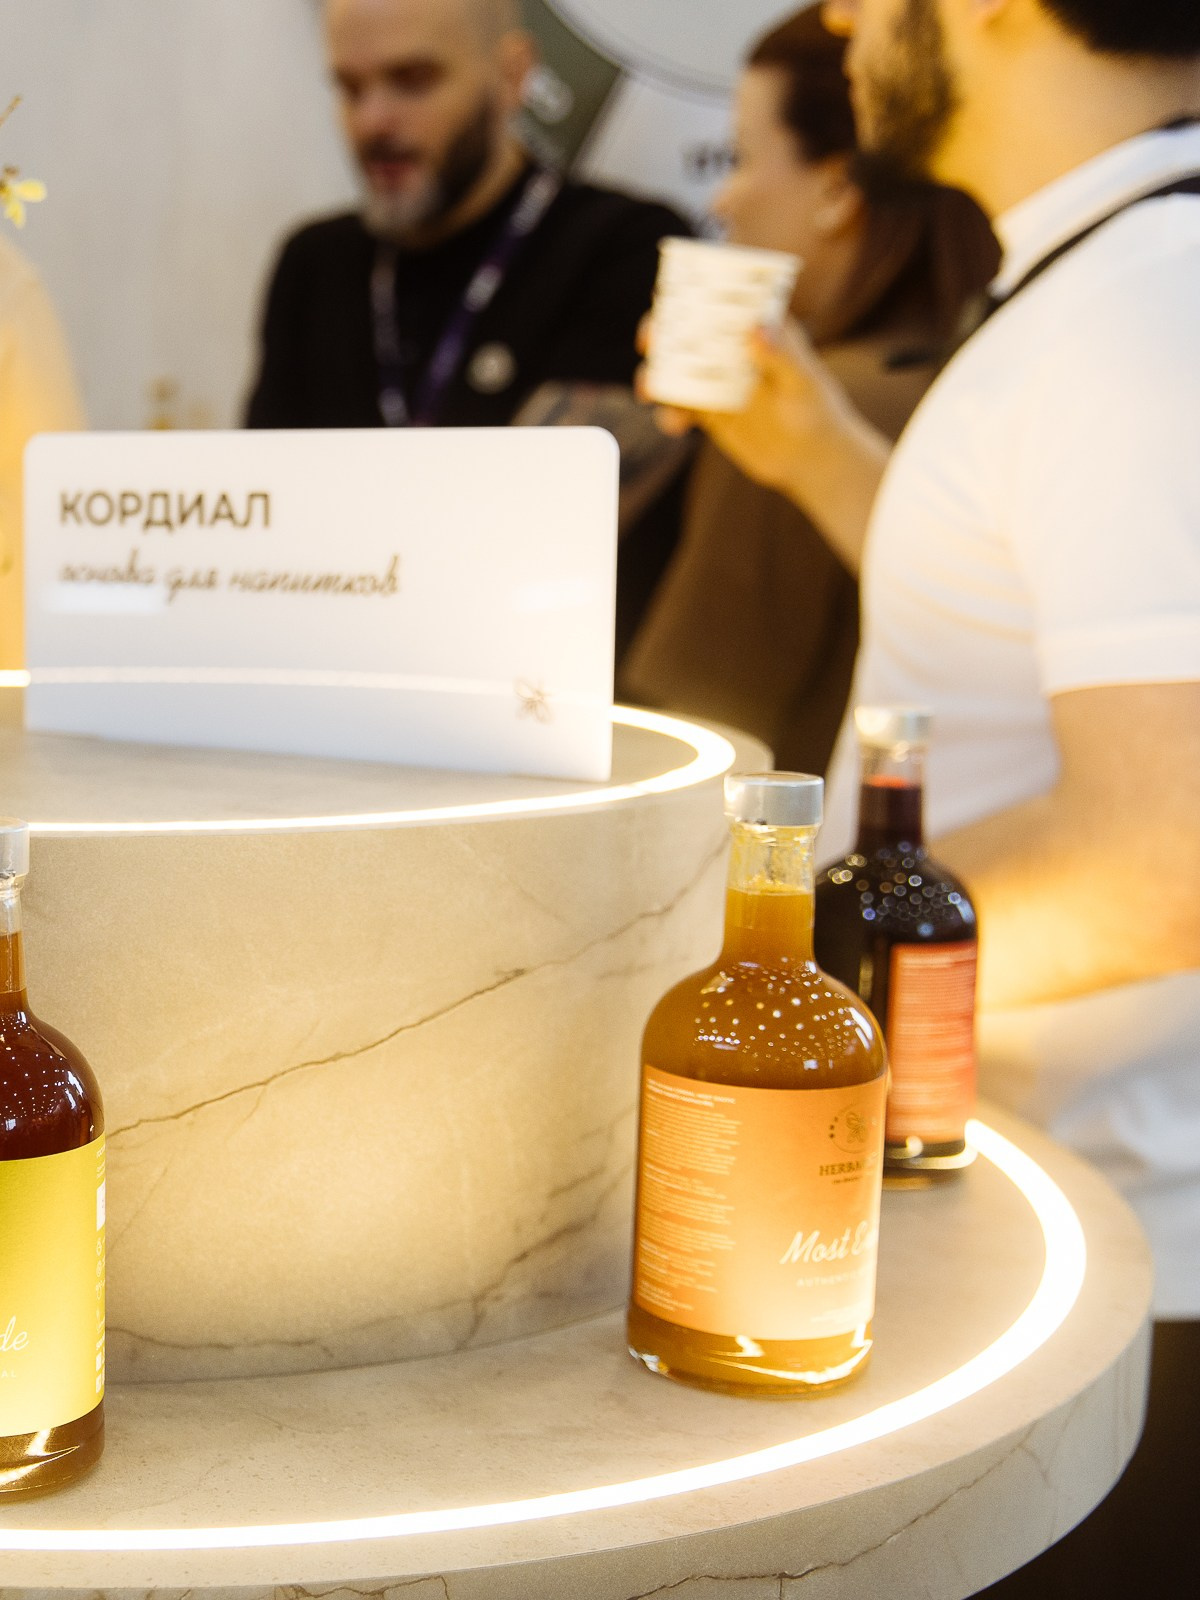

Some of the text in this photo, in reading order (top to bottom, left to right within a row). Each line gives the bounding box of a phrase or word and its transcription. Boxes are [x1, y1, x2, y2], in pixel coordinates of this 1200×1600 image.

[59, 490, 271, 533] КОРДИАЛ
[228, 553, 400, 597] напитков
[777, 1226, 852, 1265] Most
